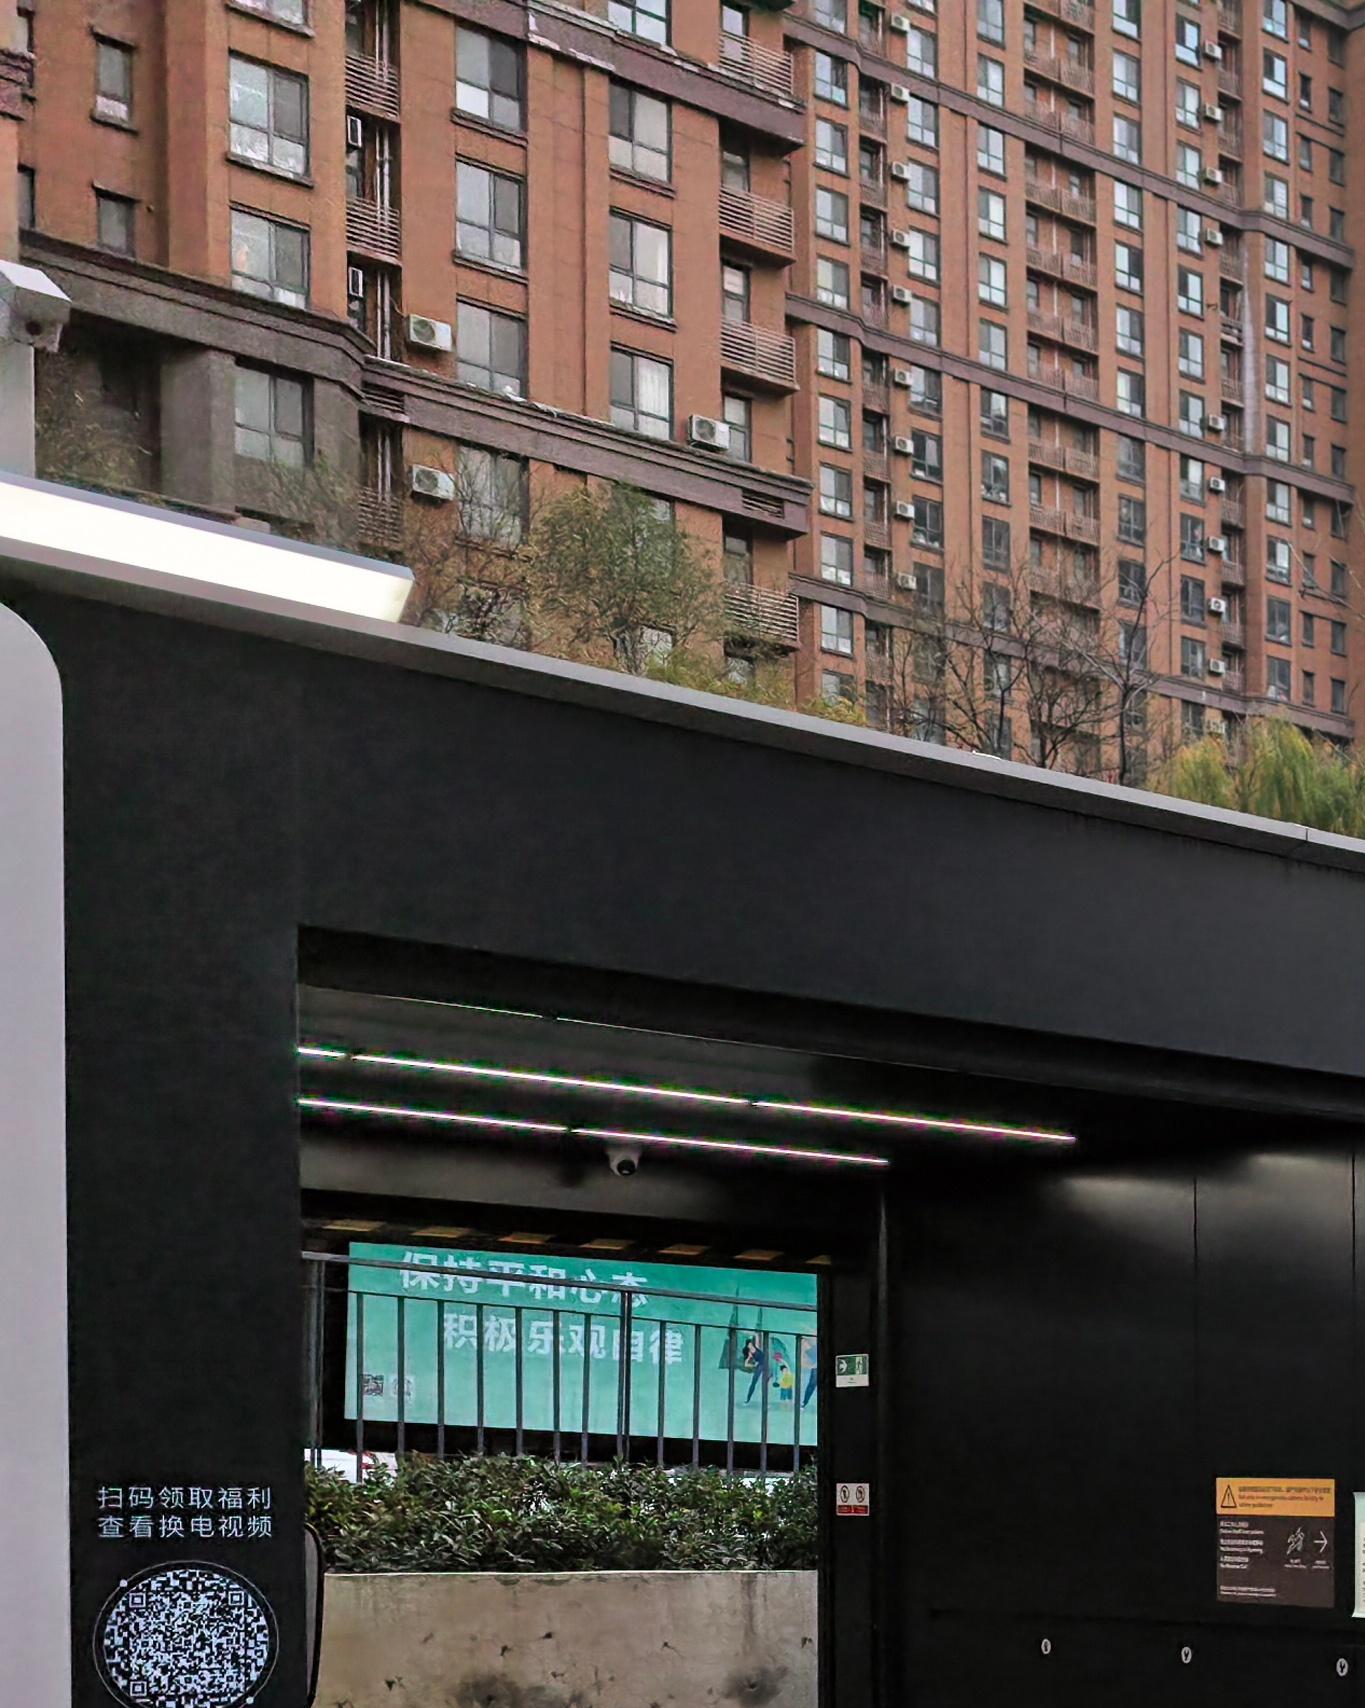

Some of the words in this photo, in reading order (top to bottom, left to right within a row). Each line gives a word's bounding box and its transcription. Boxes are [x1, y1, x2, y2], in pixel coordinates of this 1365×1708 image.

[401, 1251, 649, 1308] 保持平和心态
[442, 1311, 684, 1365] 积极乐观自律
[97, 1486, 272, 1510] 扫码领取福利
[97, 1515, 272, 1539] 查看换电视频
